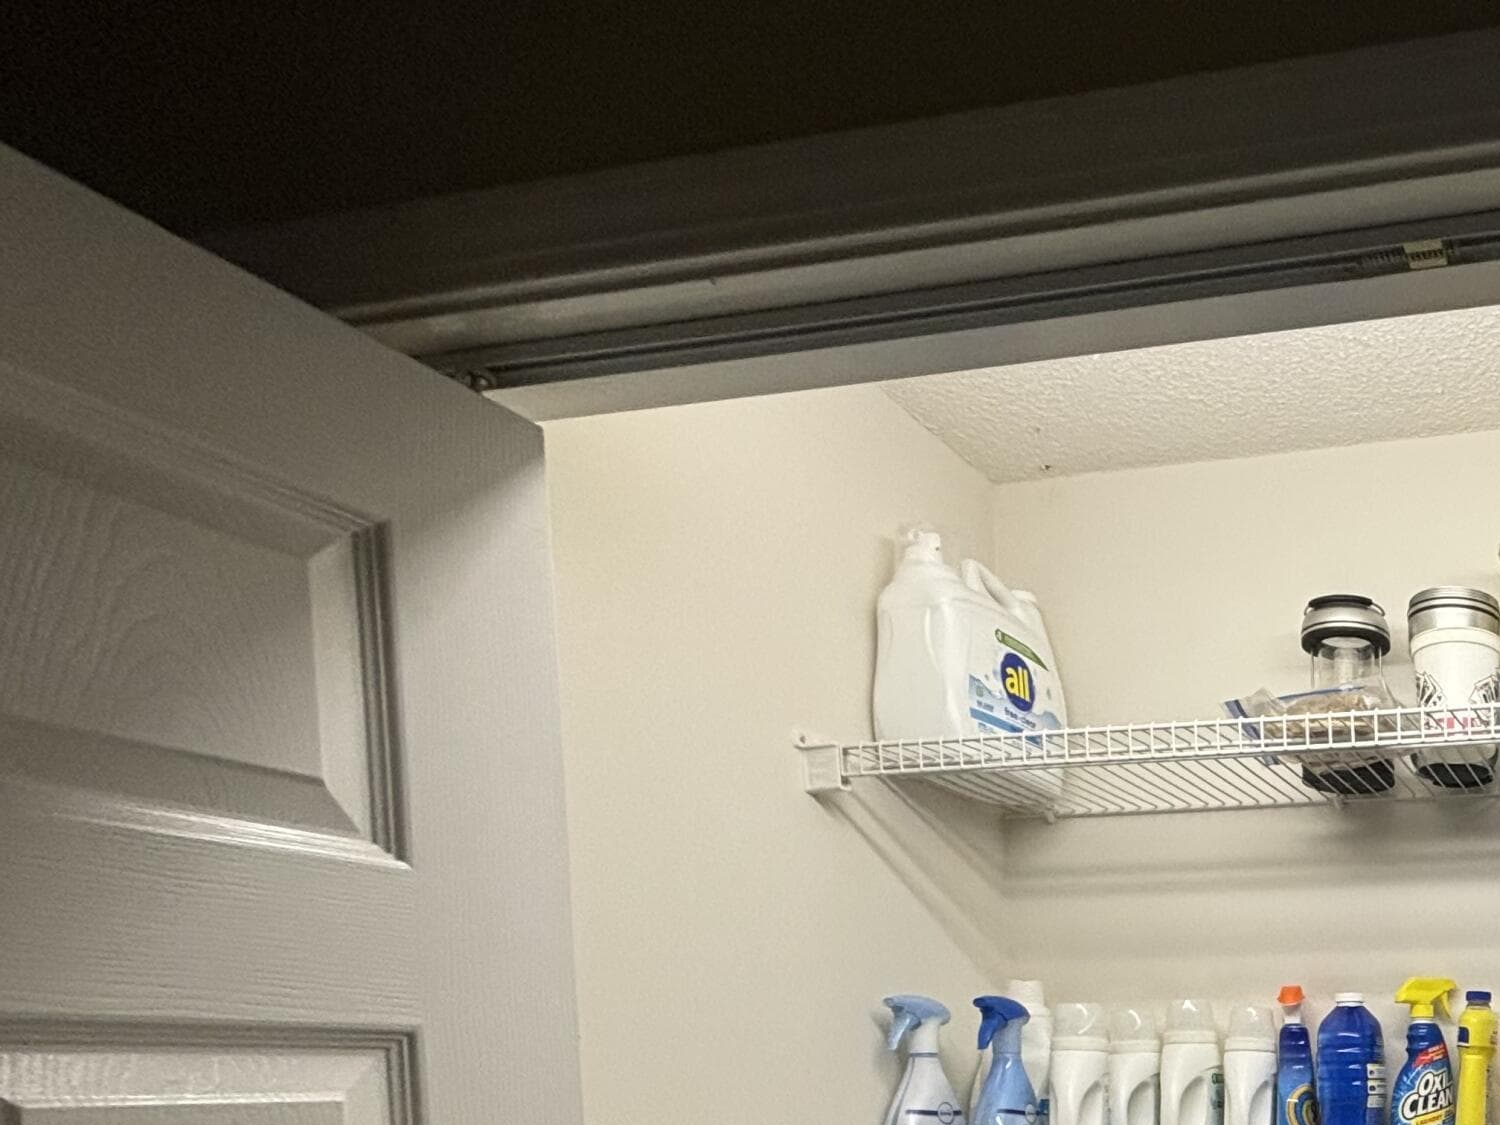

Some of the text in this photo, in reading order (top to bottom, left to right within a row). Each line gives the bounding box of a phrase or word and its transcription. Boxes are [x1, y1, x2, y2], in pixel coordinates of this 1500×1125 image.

[1005, 666, 1030, 702] all
[1418, 1071, 1446, 1096] OXI
[1402, 1085, 1454, 1120] CLEAN
